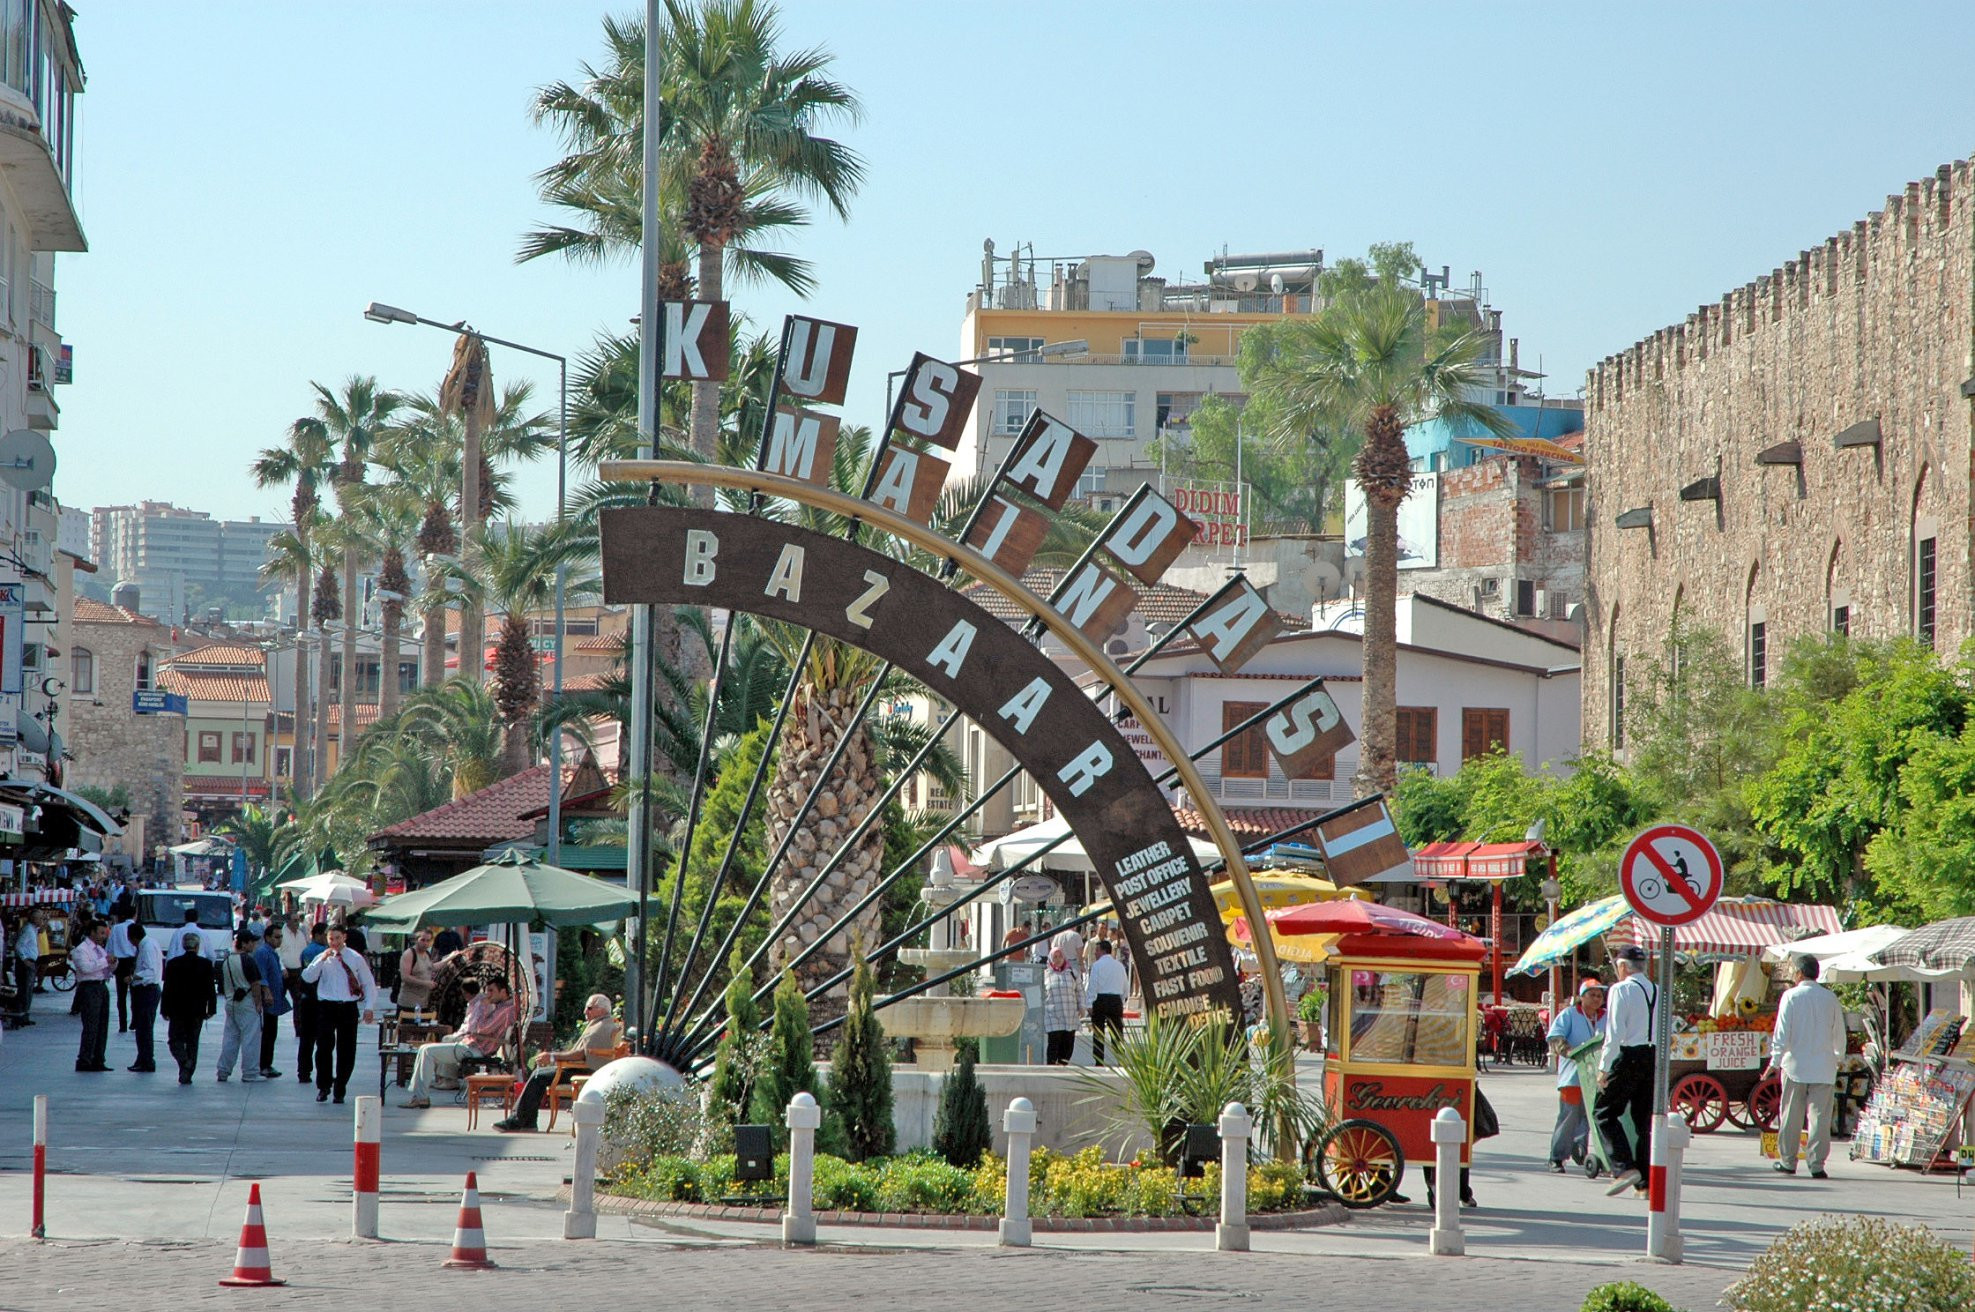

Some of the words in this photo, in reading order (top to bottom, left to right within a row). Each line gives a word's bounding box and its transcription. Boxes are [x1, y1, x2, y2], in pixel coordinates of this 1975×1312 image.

[683, 528, 1114, 798] BAZAAR
[1115, 840, 1171, 877] LEATHER
[1113, 871, 1148, 900] POST
[1149, 855, 1190, 885] OFFICE
[1125, 877, 1193, 920] JEWELLERY
[1139, 901, 1193, 935] CARPET
[1144, 921, 1209, 957] SOUVENIR
[1154, 946, 1208, 976] TEXTILE
[1153, 975, 1185, 999] FAST
[1189, 966, 1224, 989] FOOD
[1156, 993, 1212, 1019] CHANGE
[1710, 1046, 1758, 1058] ORANGE
[1713, 1032, 1755, 1047] FRESH
[1715, 1057, 1747, 1068] JUICE
